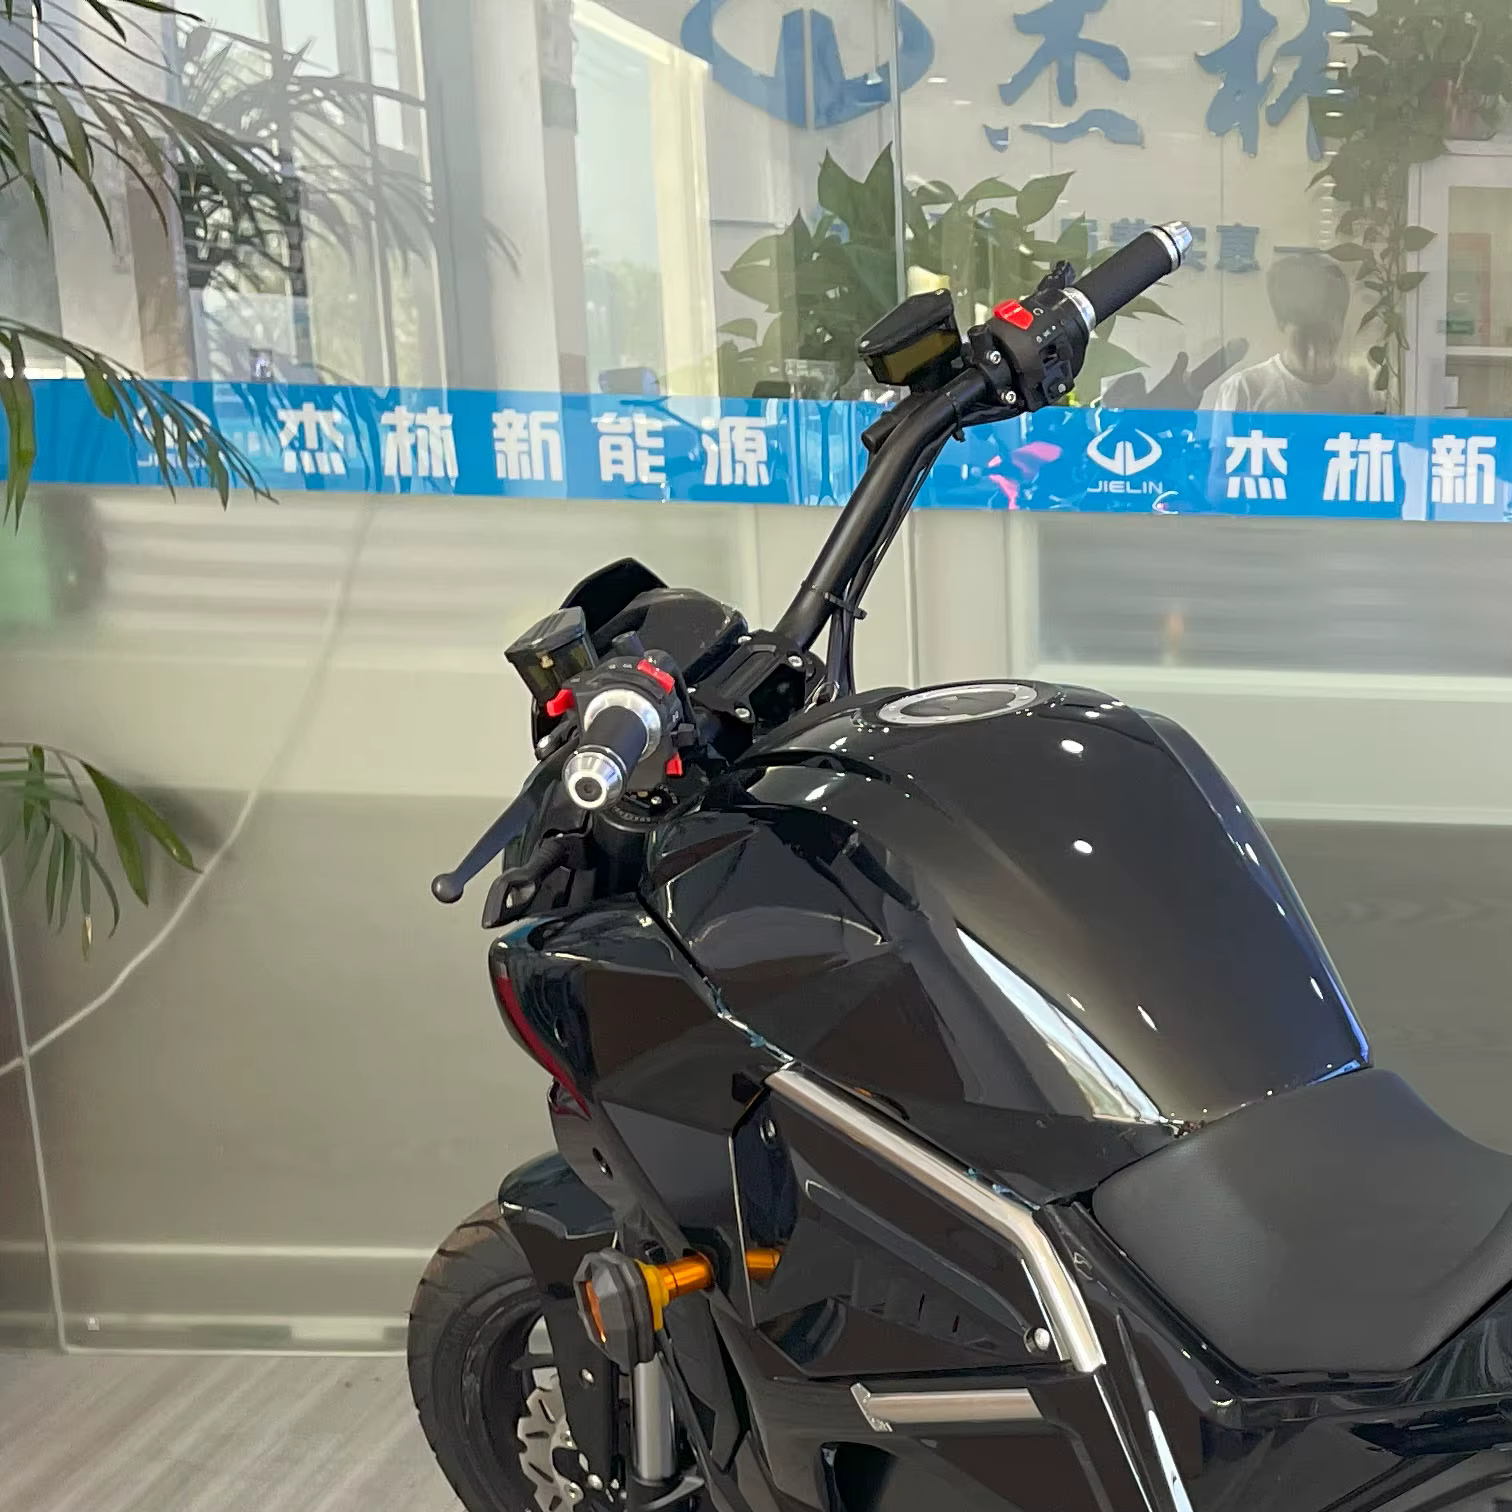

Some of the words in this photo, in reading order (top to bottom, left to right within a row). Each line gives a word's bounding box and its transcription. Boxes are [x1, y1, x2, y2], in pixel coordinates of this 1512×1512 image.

[277, 402, 770, 487] 杰林新能源
[1086, 480, 1163, 494] JIELIN
